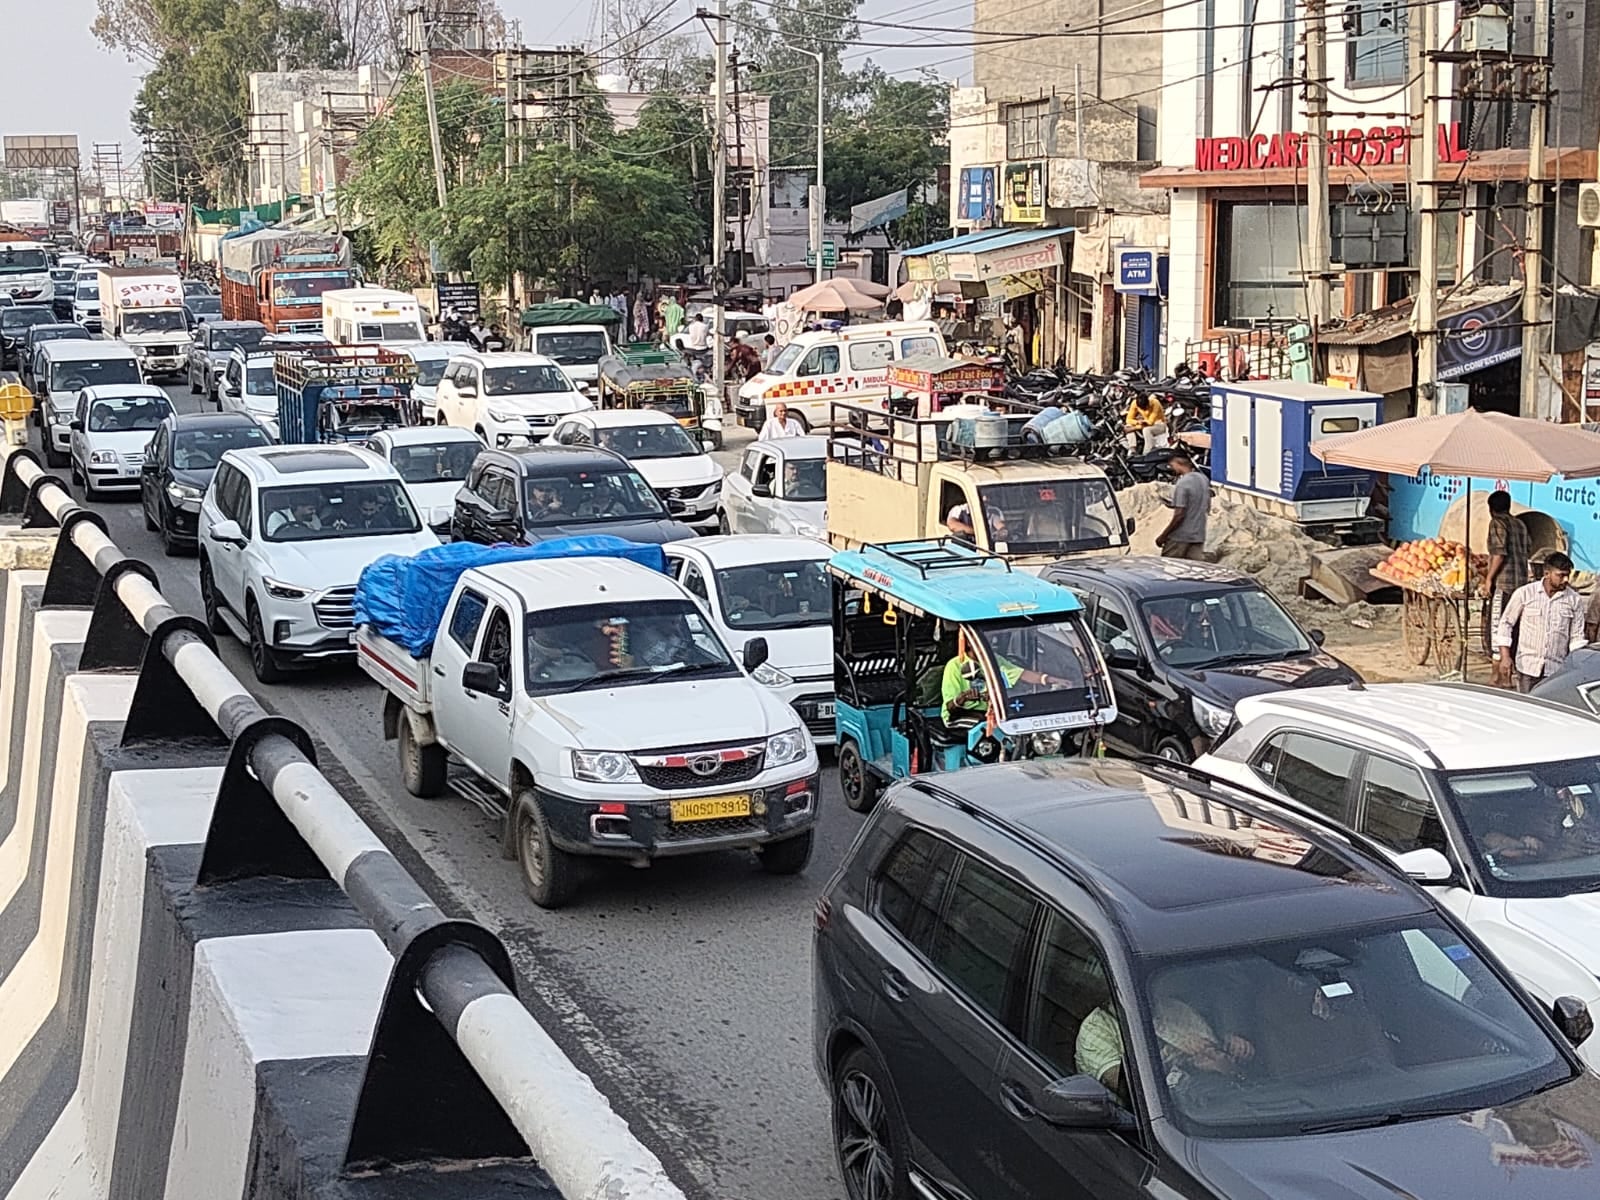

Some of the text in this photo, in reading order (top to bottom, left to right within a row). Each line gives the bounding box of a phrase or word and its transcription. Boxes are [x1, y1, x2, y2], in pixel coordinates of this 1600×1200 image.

[1327, 120, 1469, 166] HOSPIAL
[1127, 270, 1146, 278] ATM
[121, 284, 177, 297] SBTTS
[1437, 347, 1523, 380] AKESH CONFECTIONER
[863, 376, 888, 384] AMBULA
[960, 370, 975, 379] Fast
[976, 369, 993, 378] Food
[1555, 486, 1596, 506] ncrtc
